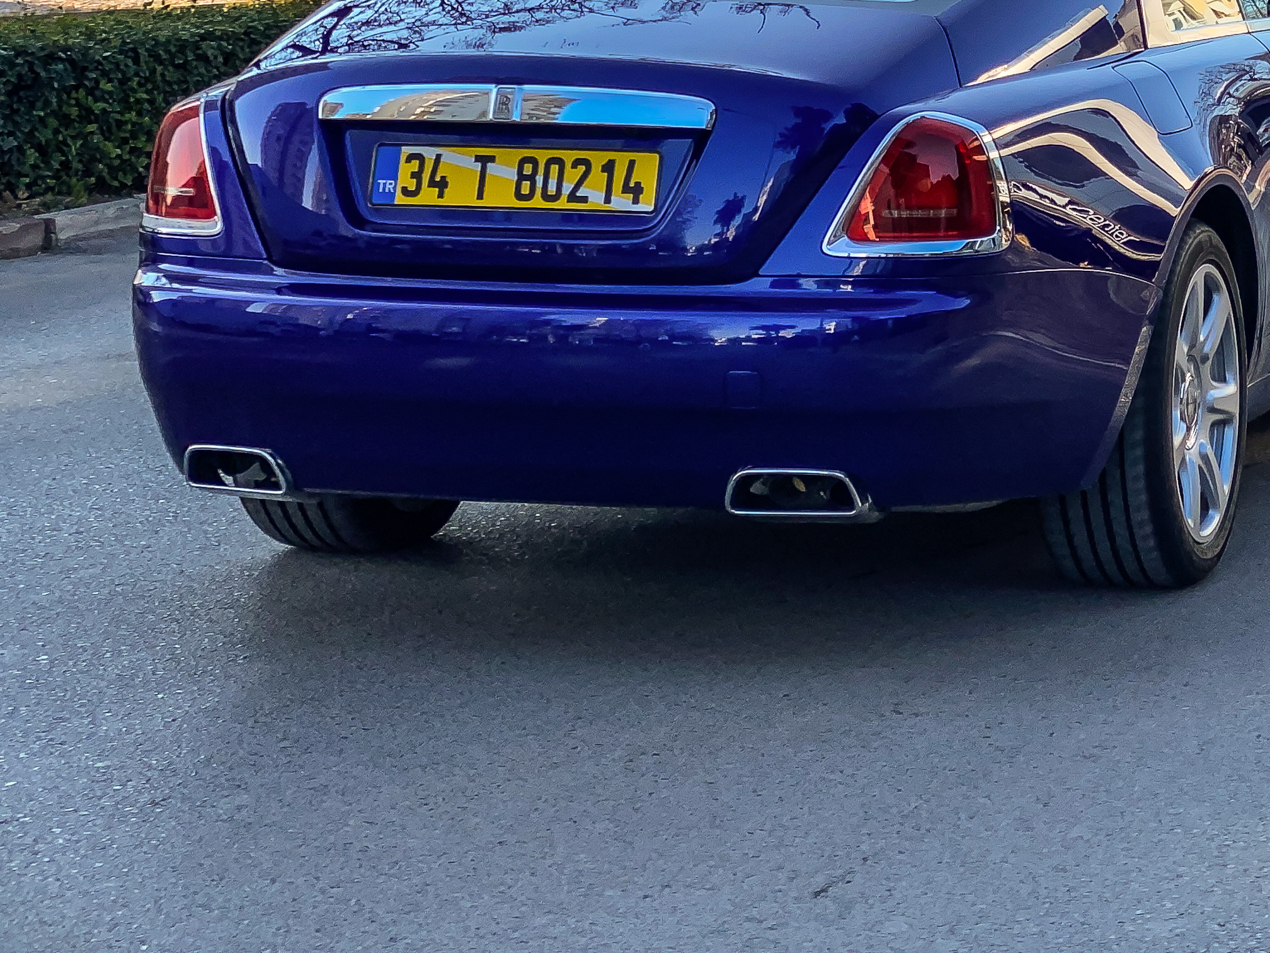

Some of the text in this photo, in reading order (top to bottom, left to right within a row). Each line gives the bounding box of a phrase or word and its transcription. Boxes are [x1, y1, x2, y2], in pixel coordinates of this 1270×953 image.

[377, 179, 395, 193] TR
[400, 152, 645, 206] 34 T 80214
